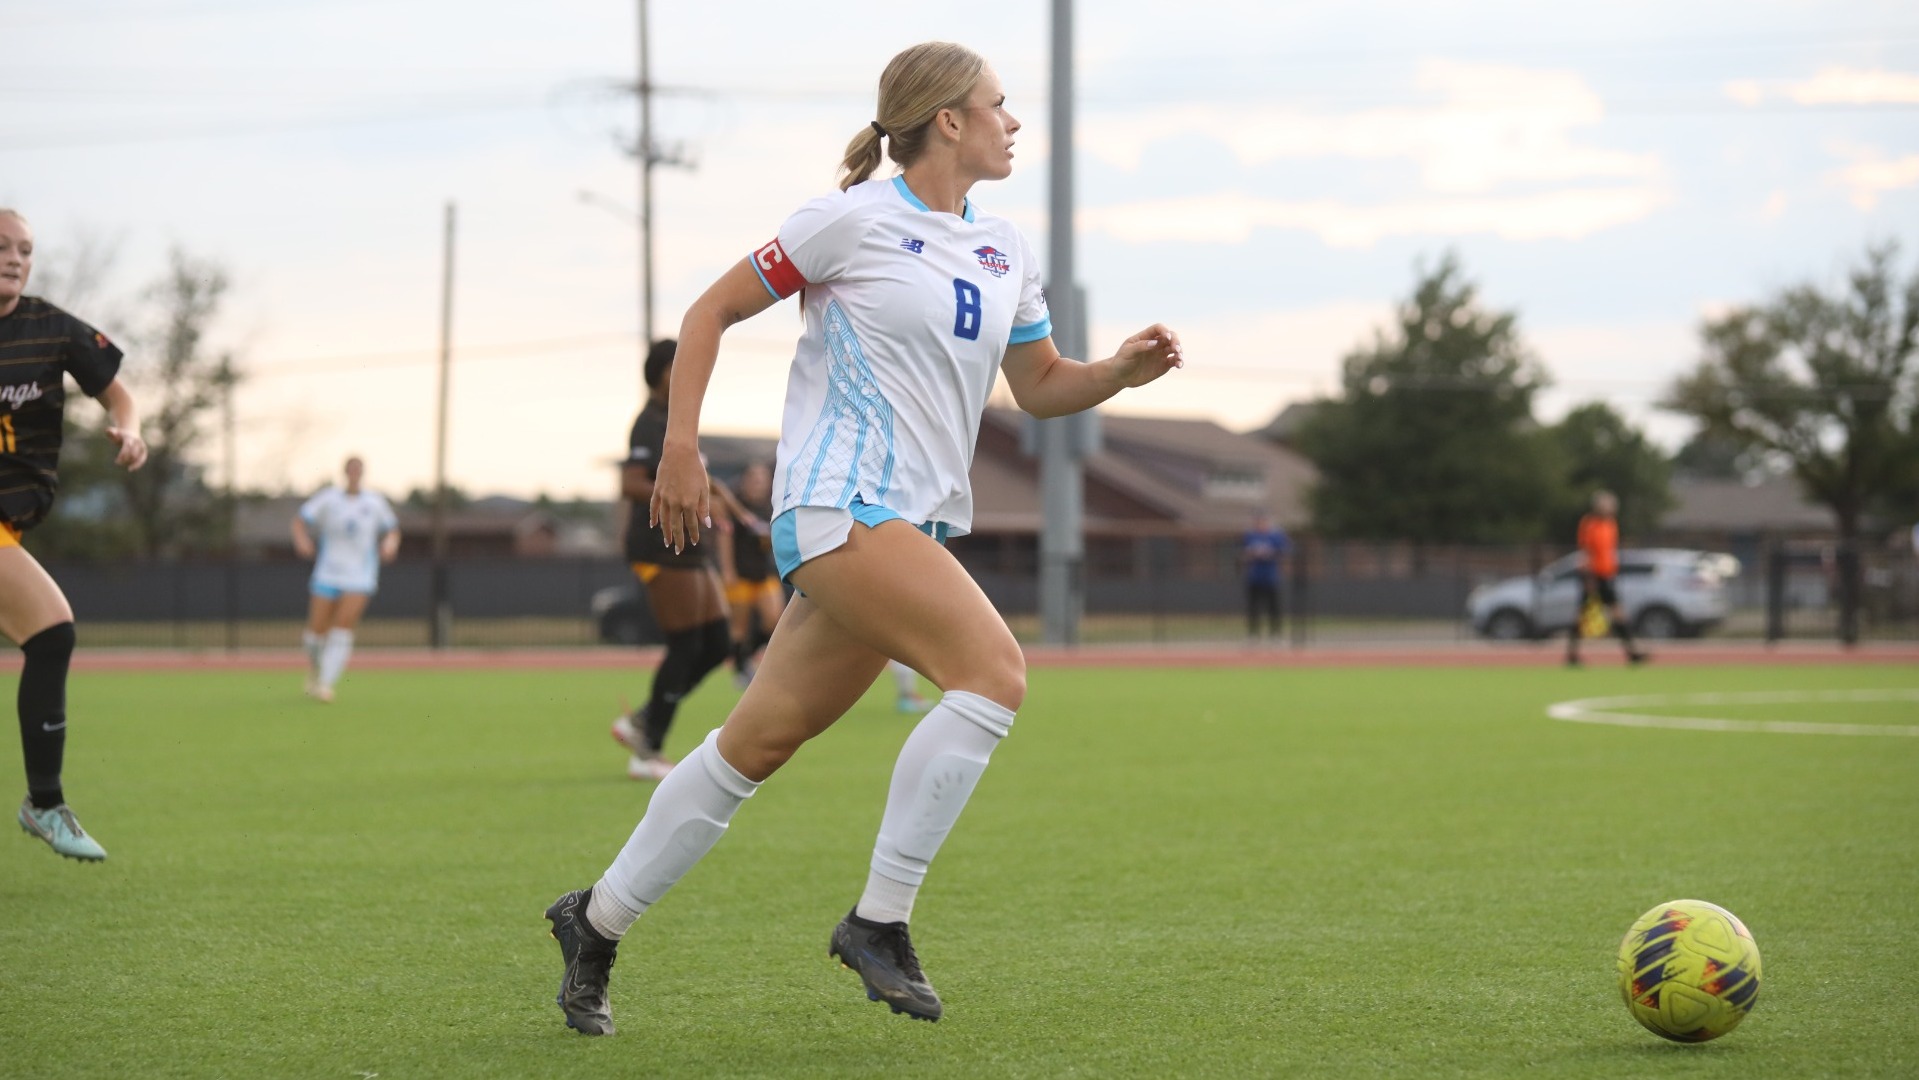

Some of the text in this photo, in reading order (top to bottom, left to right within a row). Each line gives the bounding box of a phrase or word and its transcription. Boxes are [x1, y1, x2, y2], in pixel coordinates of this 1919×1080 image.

[757, 242, 783, 270] C
[953, 277, 982, 341] 8
[0, 381, 42, 410] ngs
